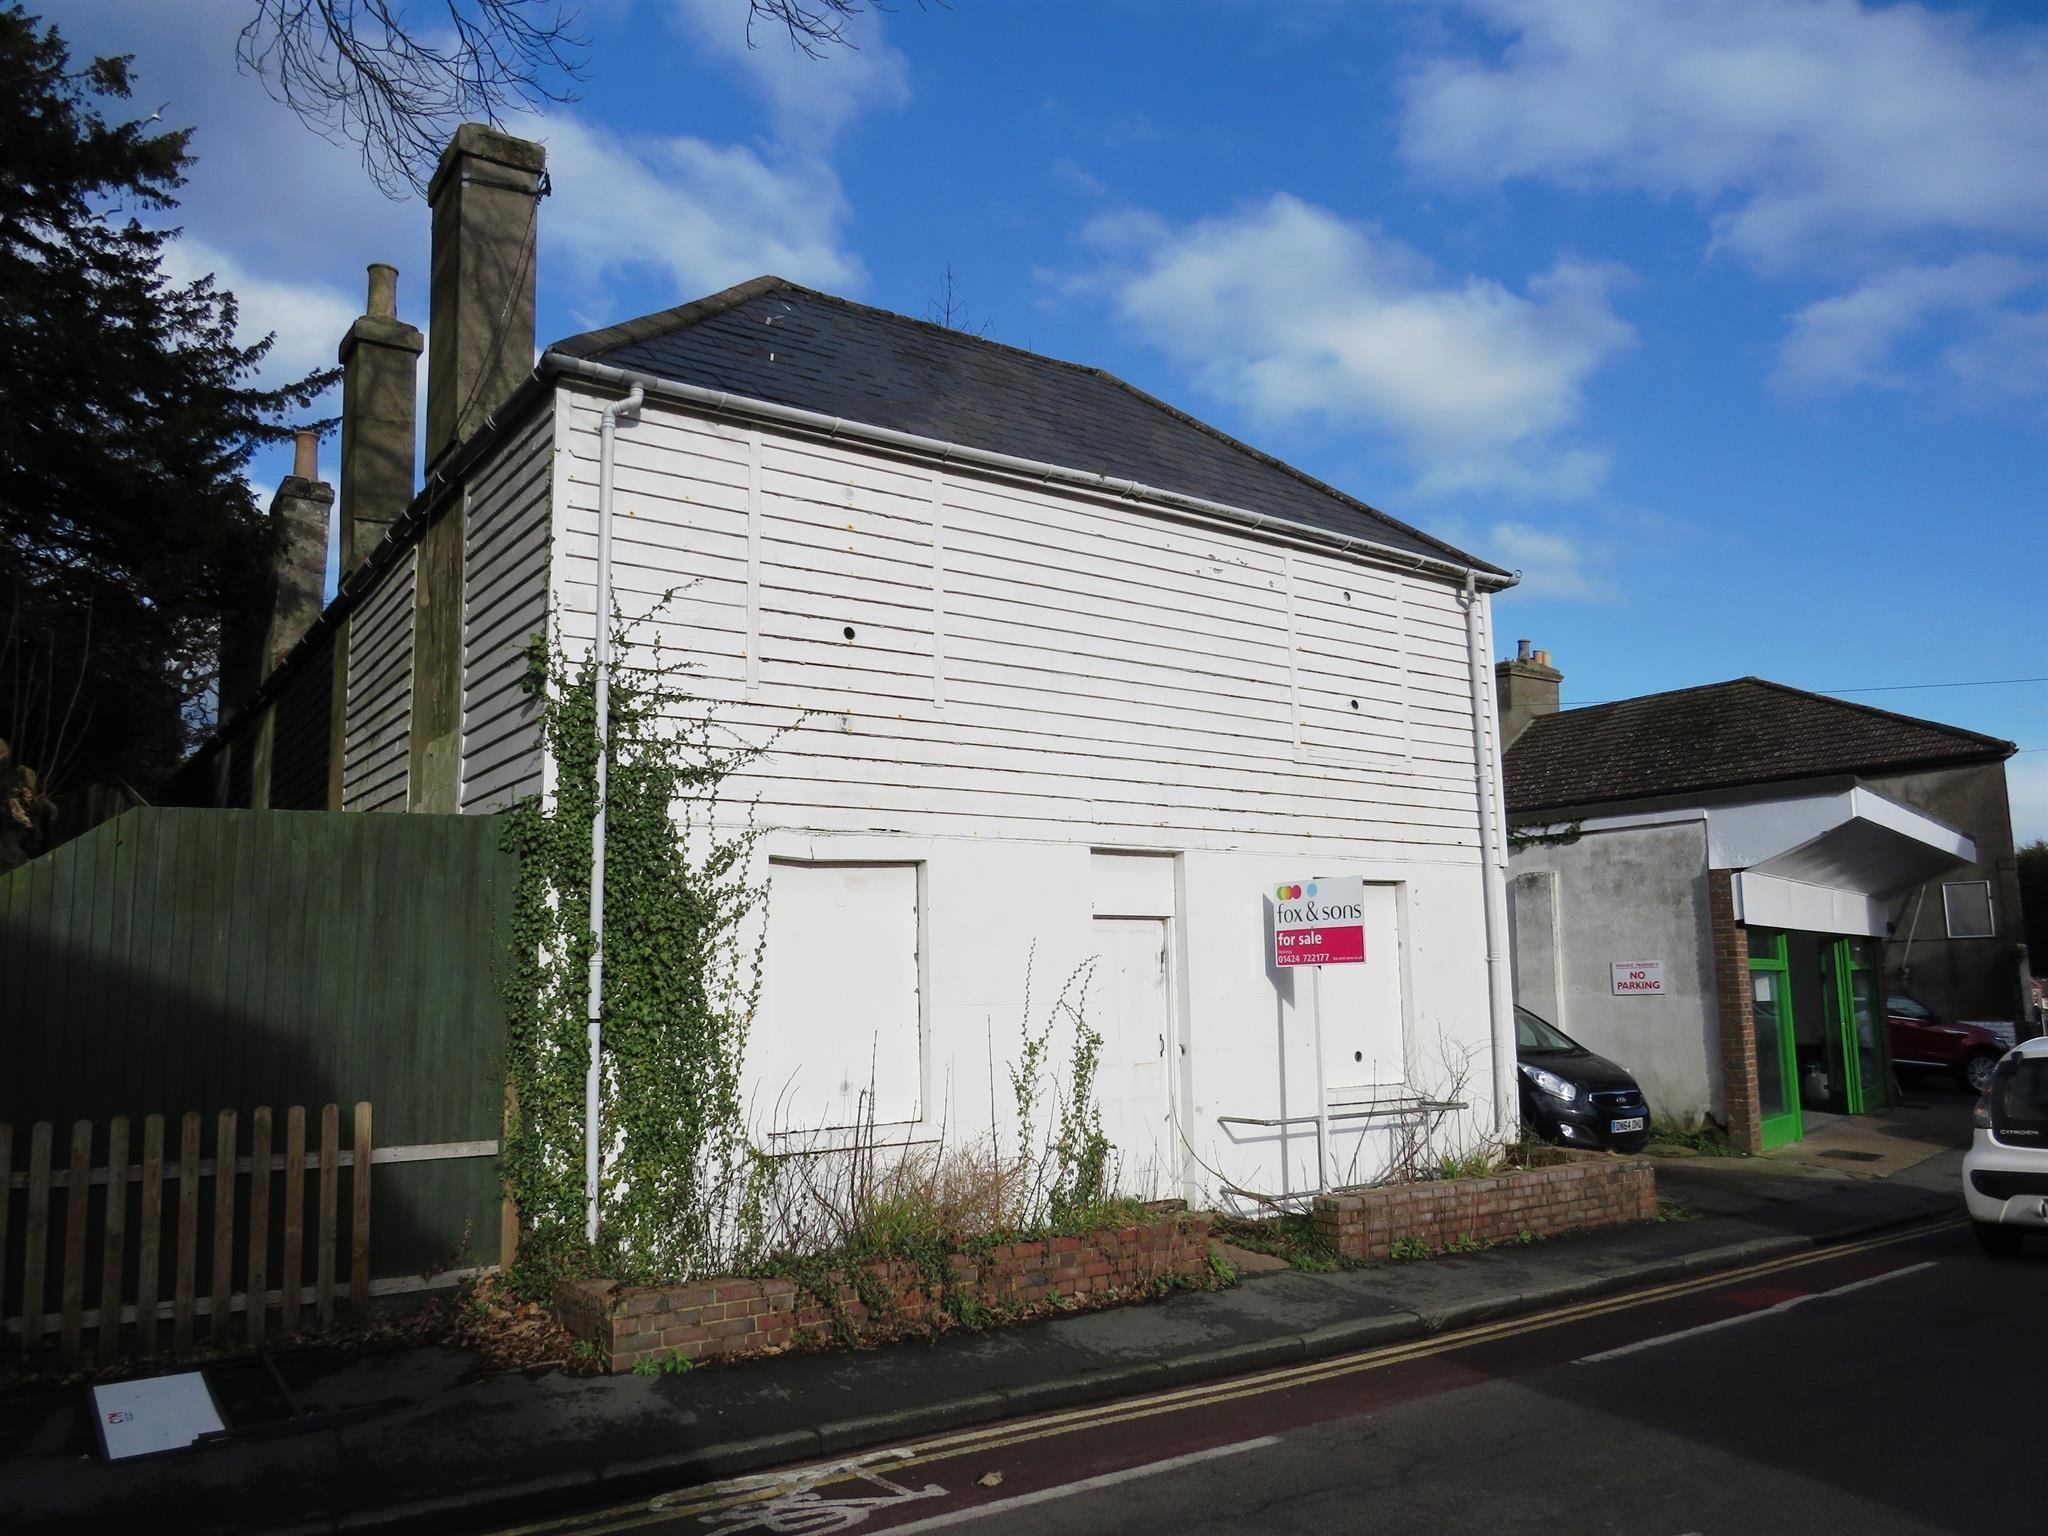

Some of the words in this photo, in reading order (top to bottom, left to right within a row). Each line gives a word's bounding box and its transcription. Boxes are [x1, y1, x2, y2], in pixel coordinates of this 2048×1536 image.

[1277, 903, 1303, 924] fox
[1306, 901, 1319, 922] &
[1322, 903, 1362, 921] sons
[1278, 932, 1296, 946] for
[1298, 931, 1323, 945] sale
[1278, 954, 1300, 963] 01424
[1303, 953, 1330, 962] 722177
[1629, 971, 1646, 980] NO
[1617, 981, 1660, 990] PARKING
